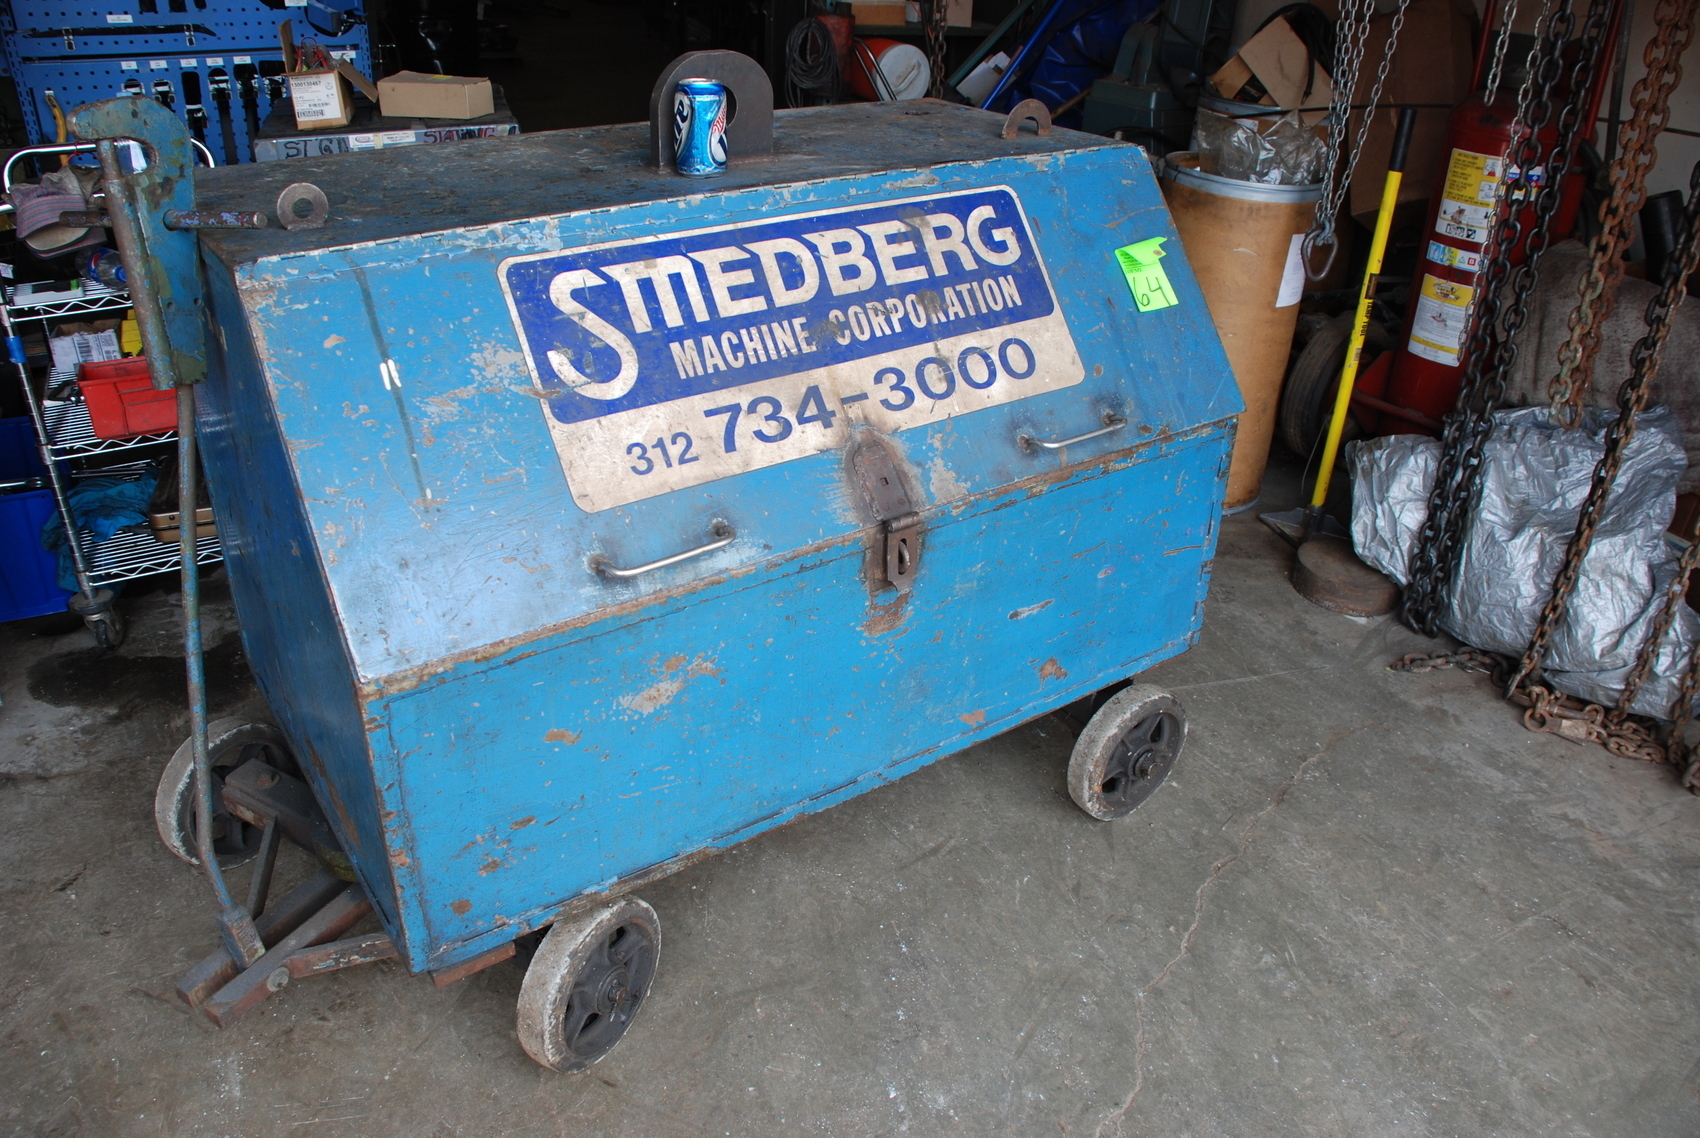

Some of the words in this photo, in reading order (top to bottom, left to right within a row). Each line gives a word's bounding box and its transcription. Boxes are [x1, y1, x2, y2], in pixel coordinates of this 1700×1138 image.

[546, 204, 1023, 402] SMEDBERG
[668, 314, 817, 380] MACHINE
[832, 274, 1023, 345] CORPORATION
[1132, 276, 1171, 307] 64
[625, 431, 700, 477] 312
[703, 337, 1037, 455] 734-3000
